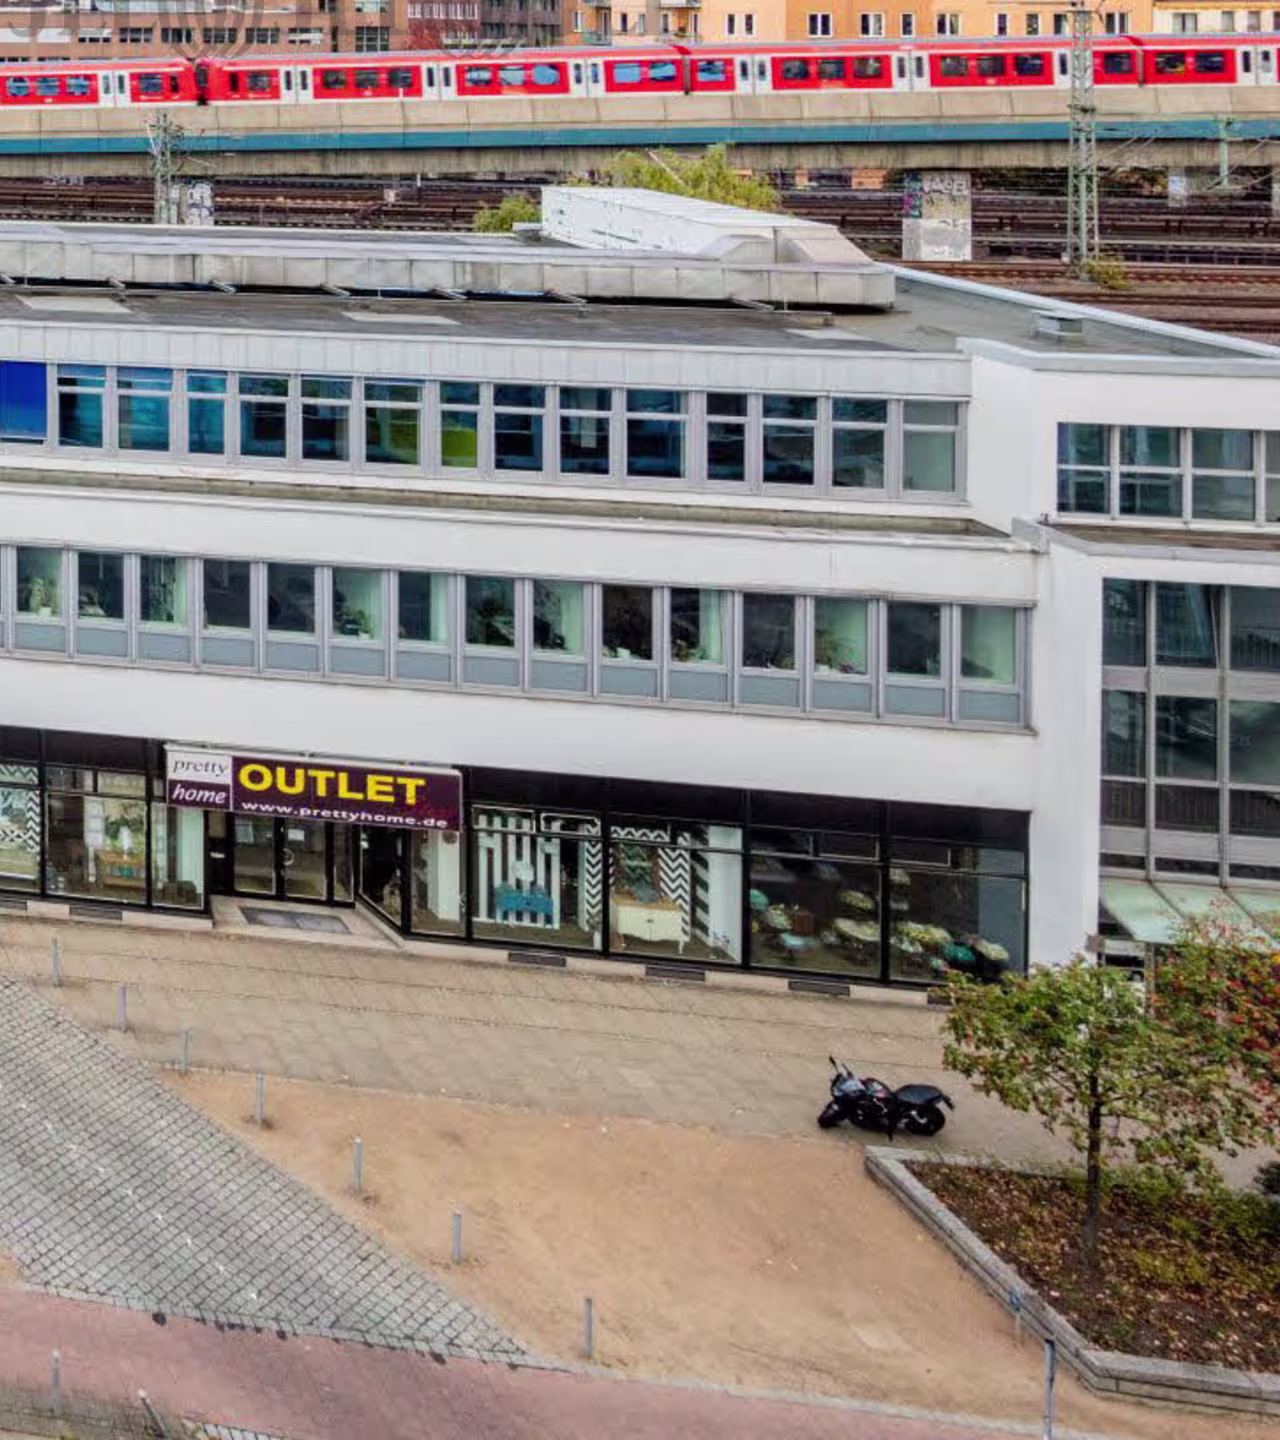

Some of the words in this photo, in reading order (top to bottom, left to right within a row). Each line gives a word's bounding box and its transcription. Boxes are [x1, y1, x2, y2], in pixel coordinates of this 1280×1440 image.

[173, 759, 228, 778] pretty
[172, 784, 226, 804] home
[239, 764, 426, 804] OUTLET
[242, 803, 448, 828] www.prettyhome.de
